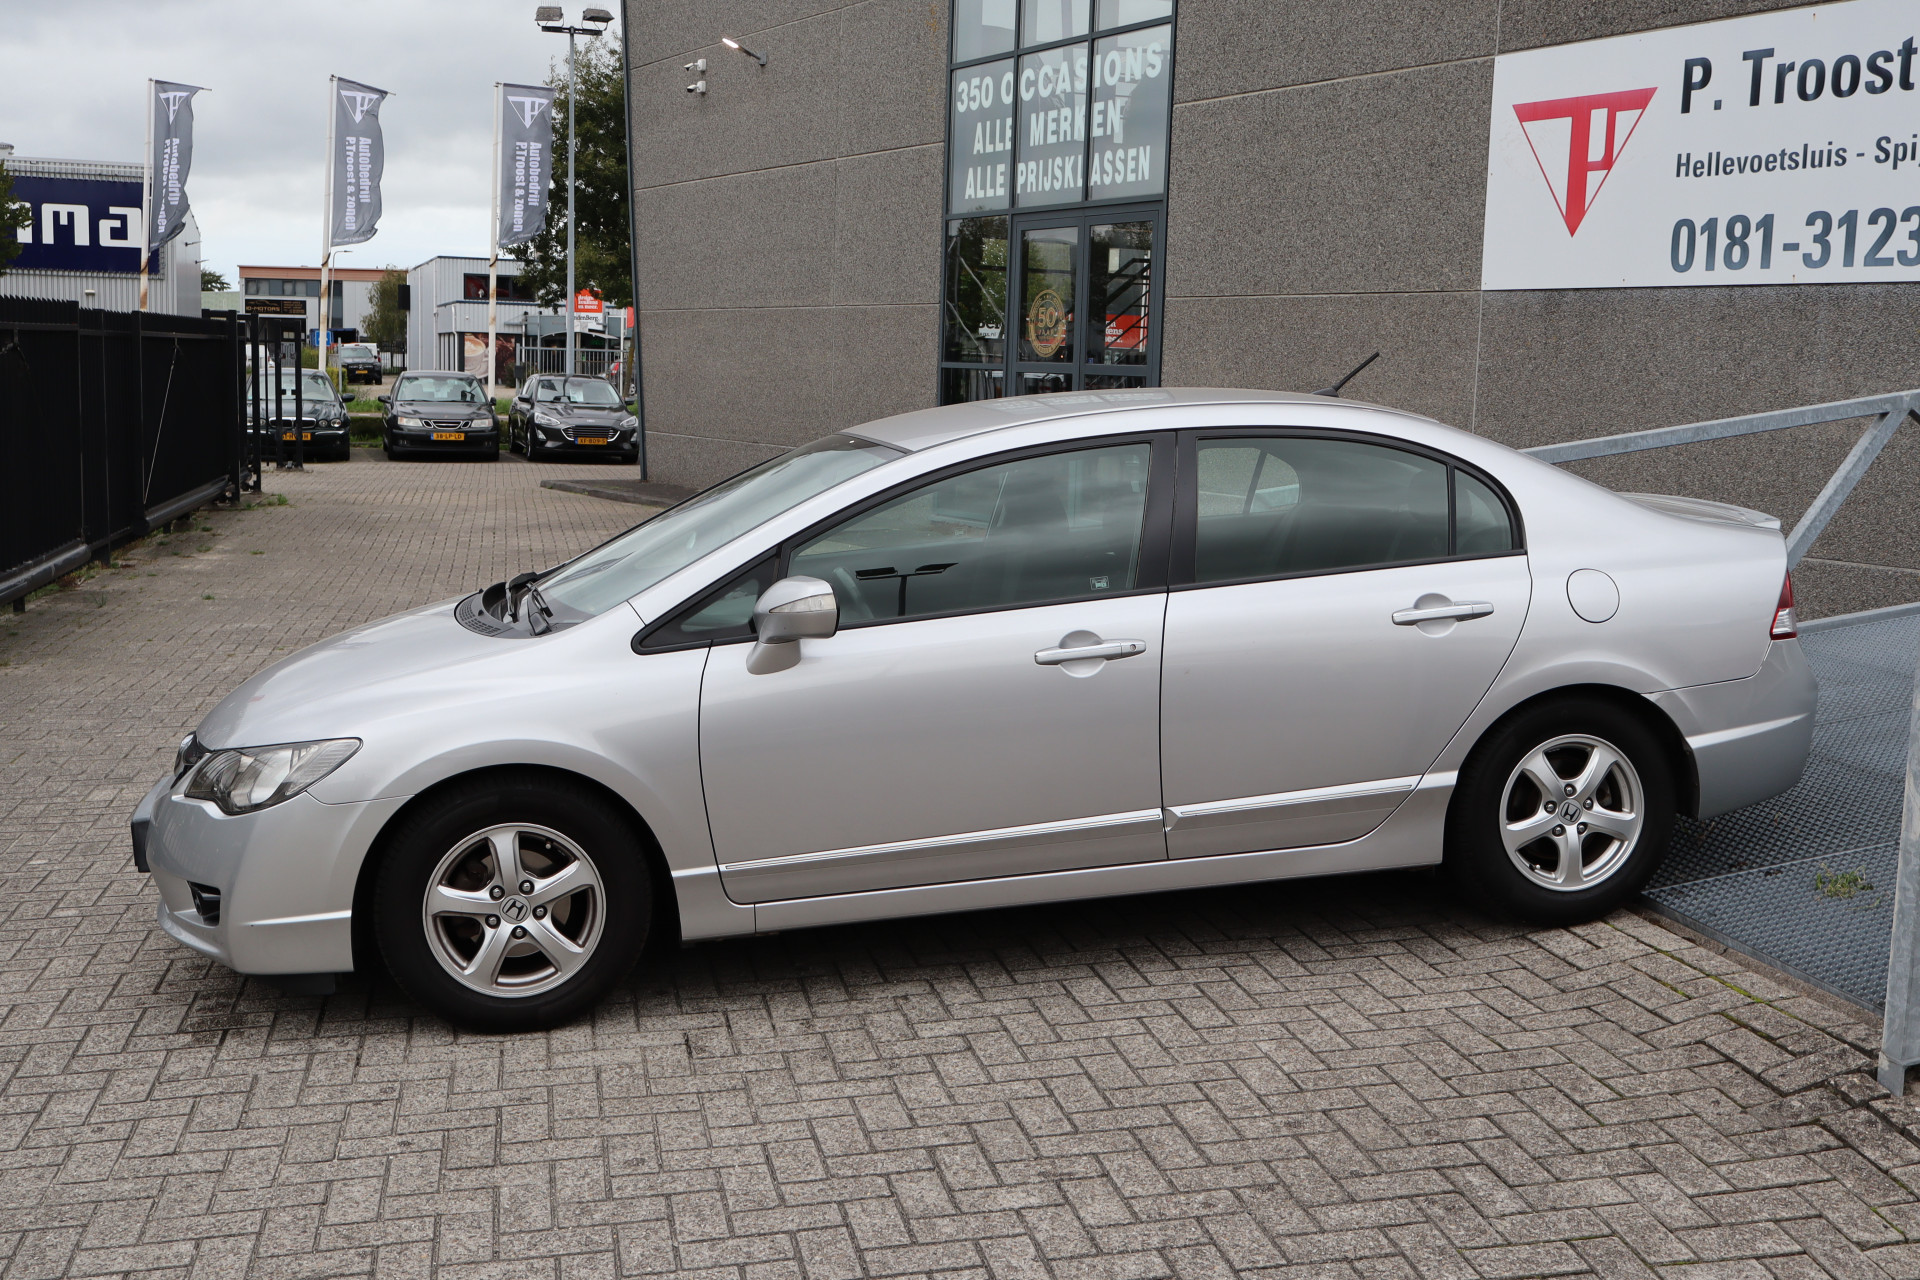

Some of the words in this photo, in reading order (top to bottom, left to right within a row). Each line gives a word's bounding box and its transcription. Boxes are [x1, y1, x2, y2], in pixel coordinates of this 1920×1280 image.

[956, 75, 994, 113] 350
[1000, 41, 1163, 105] OCCASIONS
[1680, 56, 1722, 114] P.
[1742, 35, 1919, 107] Troost
[972, 116, 1013, 155] ALLE
[1029, 98, 1122, 148] MERKEN
[527, 141, 543, 207] Autobedrijf
[964, 163, 1006, 200] ALLE
[1016, 144, 1151, 194] PRIJSKLASSEN
[1675, 140, 1848, 178] Hellevoetsluis
[1874, 133, 1920, 170] Spi
[345, 195, 357, 231] zonen
[512, 198, 525, 233] zonen
[1670, 205, 1920, 273] 0181-3123
[1037, 306, 1057, 328] 50
